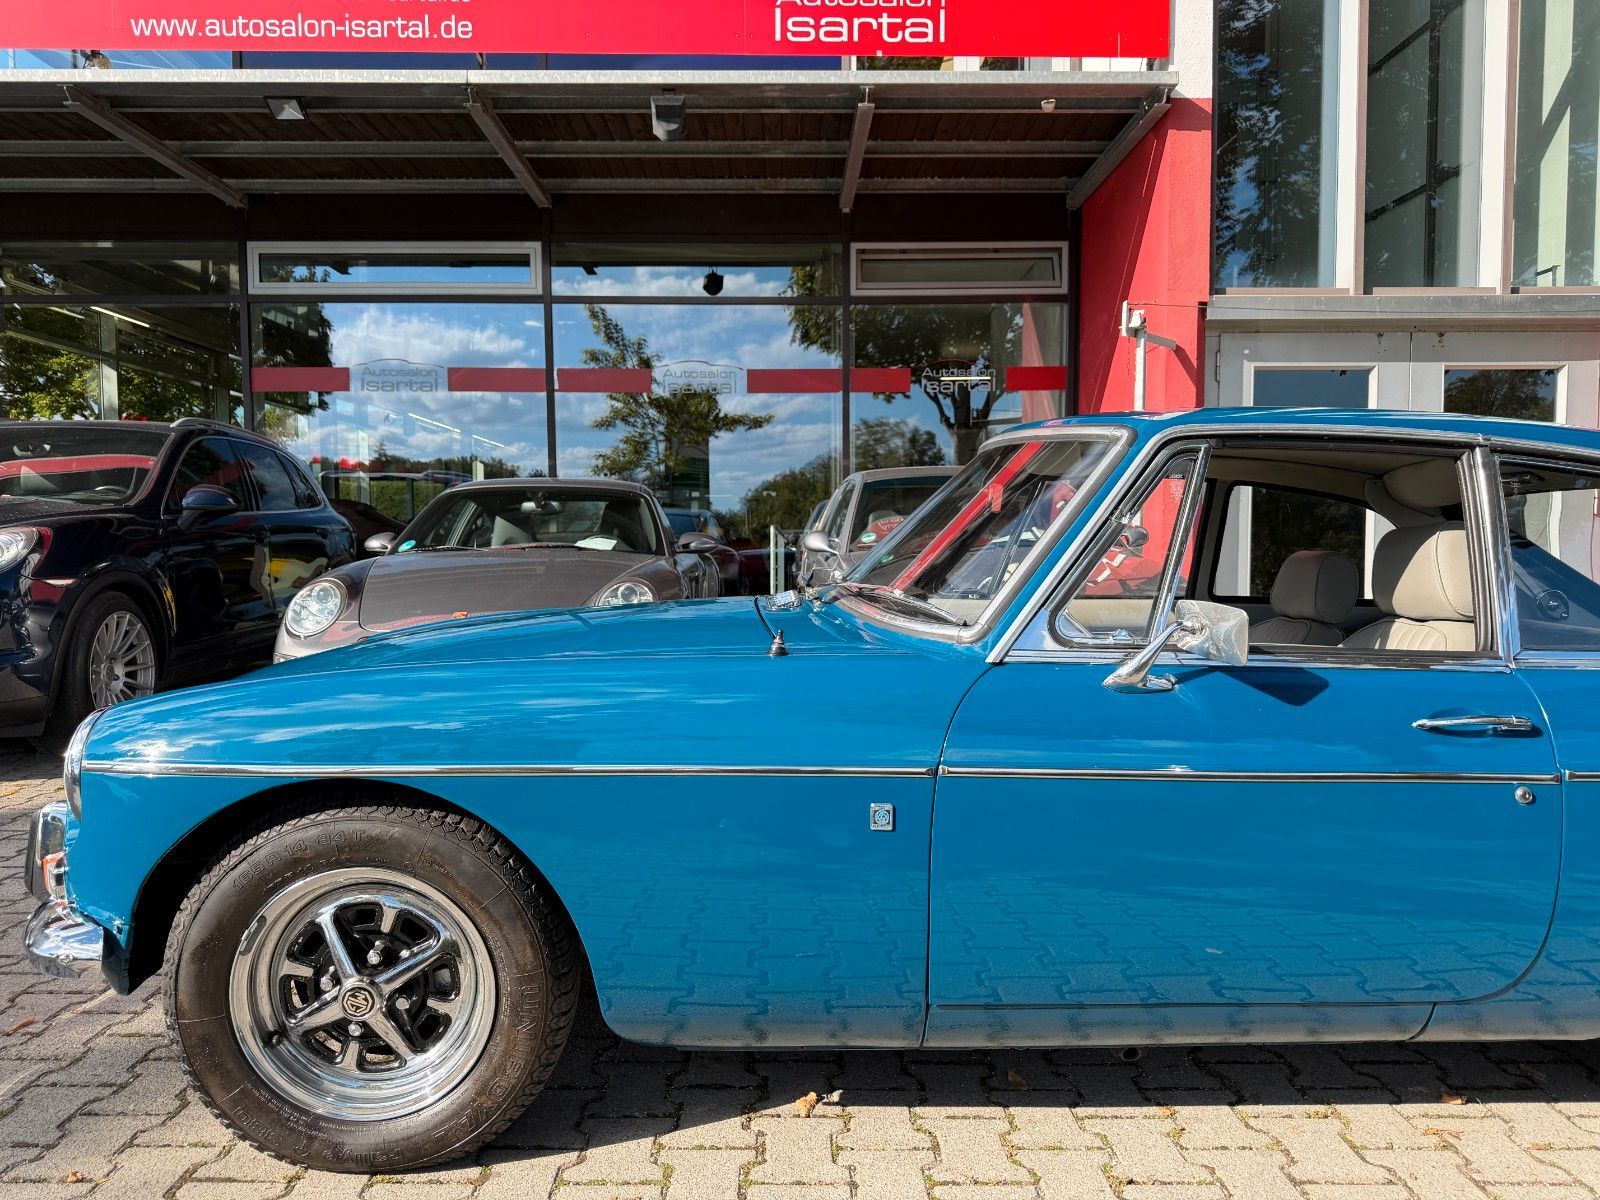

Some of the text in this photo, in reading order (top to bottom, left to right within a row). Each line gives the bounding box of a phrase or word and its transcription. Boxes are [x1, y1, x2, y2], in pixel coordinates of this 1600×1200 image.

[130, 13, 473, 39] www.autosalon-isartal.de
[774, 8, 946, 43] Isartal
[361, 367, 438, 377] Autosalon
[663, 368, 737, 378] Autosalon
[922, 367, 996, 377] Autosalon
[361, 377, 438, 392] Isartal
[662, 378, 737, 394] Isartal
[921, 377, 996, 393] Isartal
